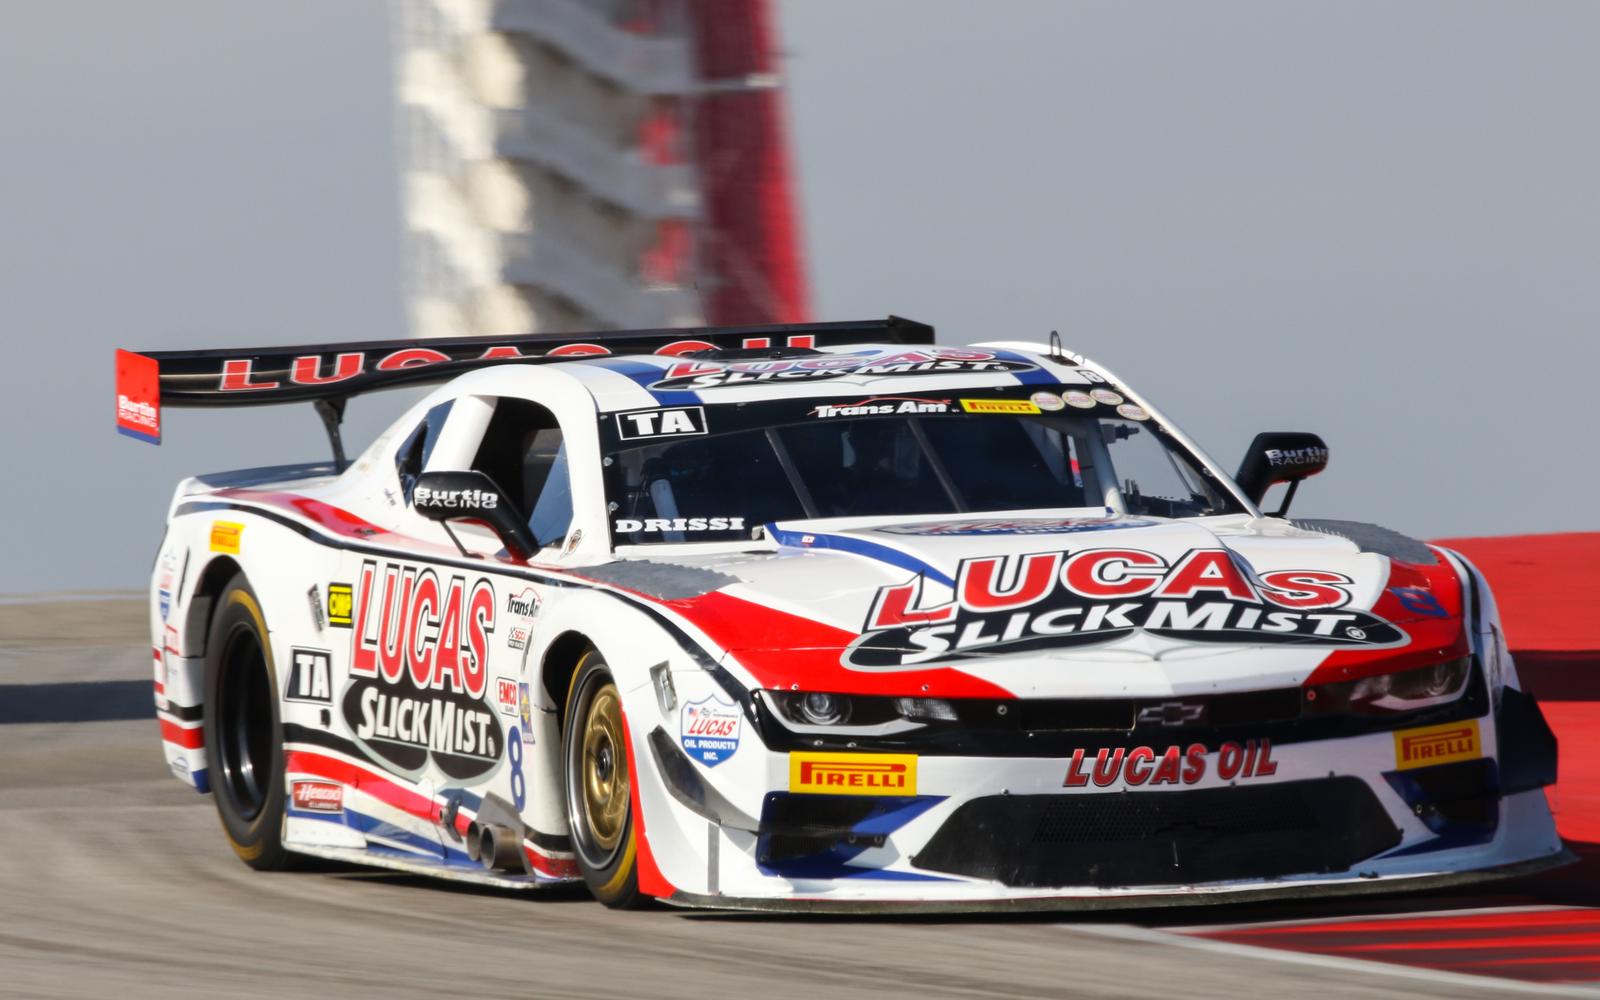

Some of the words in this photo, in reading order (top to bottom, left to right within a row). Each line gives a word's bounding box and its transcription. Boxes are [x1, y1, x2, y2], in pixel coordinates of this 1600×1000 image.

[664, 349, 996, 380] LUCAS
[118, 395, 156, 418] Burtin
[814, 403, 895, 418] Trans
[896, 401, 947, 413] Am
[967, 402, 1033, 412] PIRELLI
[626, 410, 697, 435] TA
[414, 486, 498, 502] Burtin
[414, 498, 498, 509] RACING
[615, 517, 745, 533] DRISSI
[863, 548, 1356, 631] LUCAS
[507, 593, 529, 616] Trans
[351, 561, 494, 698] LUCAS
[296, 654, 330, 698] TA
[499, 681, 517, 705] EMCO
[688, 719, 736, 736] LUCAS
[684, 739, 697, 748] OIL
[698, 740, 736, 750] PRODUCTS
[703, 751, 719, 760] INC.
[1403, 727, 1473, 761] PIRELLI
[508, 725, 526, 813] 8
[800, 761, 906, 787] PIRELLI
[1063, 743, 1208, 787] LUCAS
[1216, 738, 1279, 781] OIL
